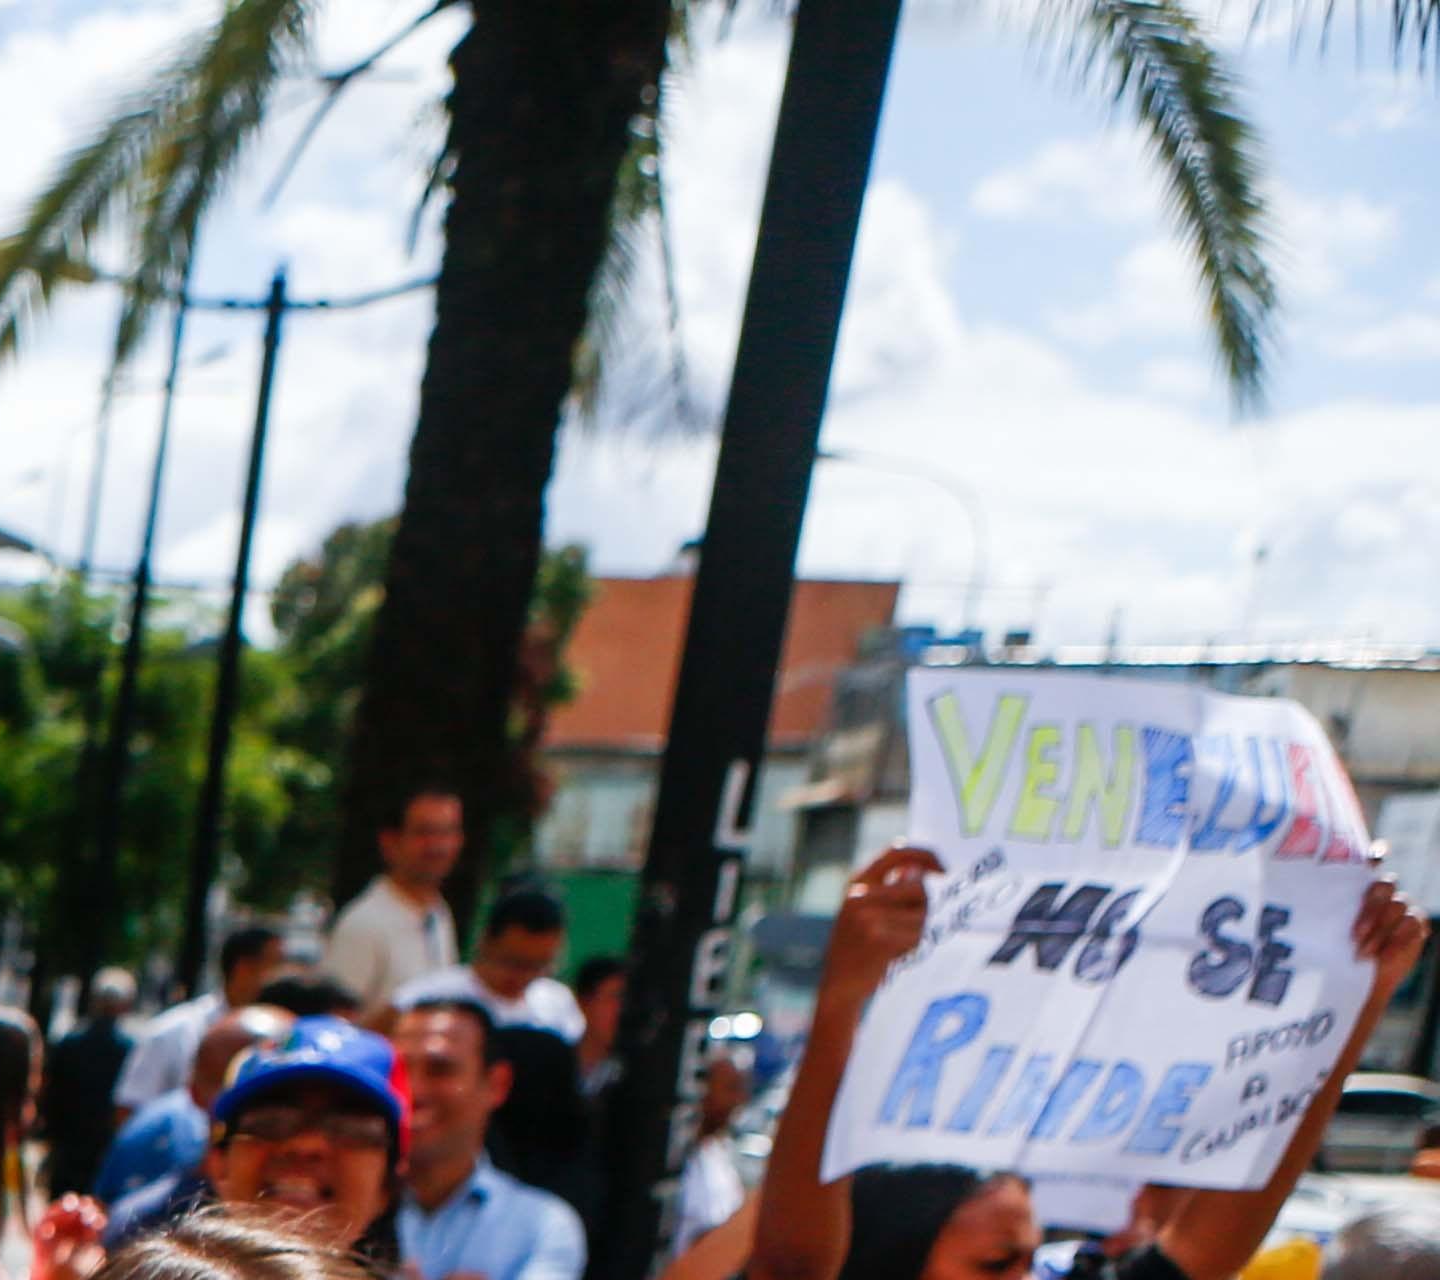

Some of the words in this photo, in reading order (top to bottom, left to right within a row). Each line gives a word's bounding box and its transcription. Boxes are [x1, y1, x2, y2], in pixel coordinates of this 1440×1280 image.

[988, 881, 1145, 983] NO
[1189, 897, 1297, 1007] SE
[878, 992, 1213, 1156] RINDE
